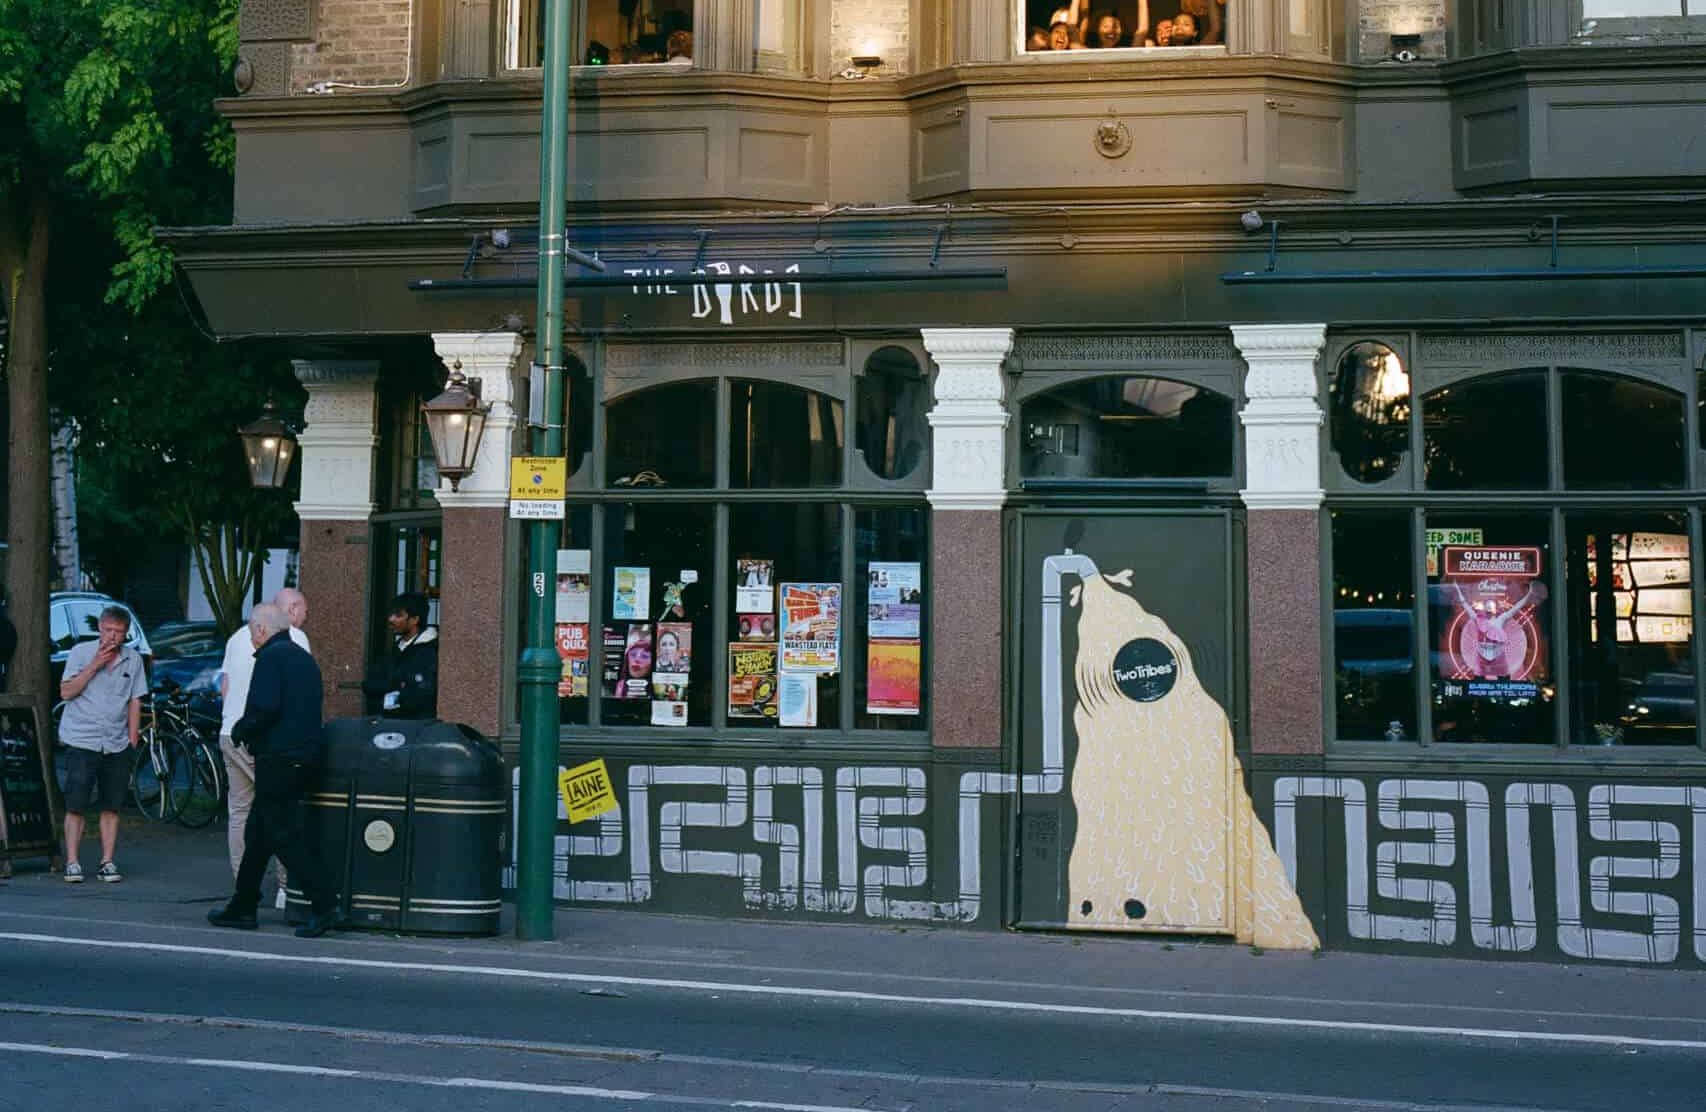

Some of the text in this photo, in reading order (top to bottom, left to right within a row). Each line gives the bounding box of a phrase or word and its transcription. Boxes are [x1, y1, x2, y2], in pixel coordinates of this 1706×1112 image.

[624, 269, 678, 294] THE
[1449, 531, 1479, 543] SOME
[1463, 552, 1521, 561] QUEENIE
[559, 627, 583, 639] PUB
[562, 639, 587, 650] QUIZ
[784, 640, 836, 649] WANSTEAD FLATS
[566, 774, 606, 805] LAINE
